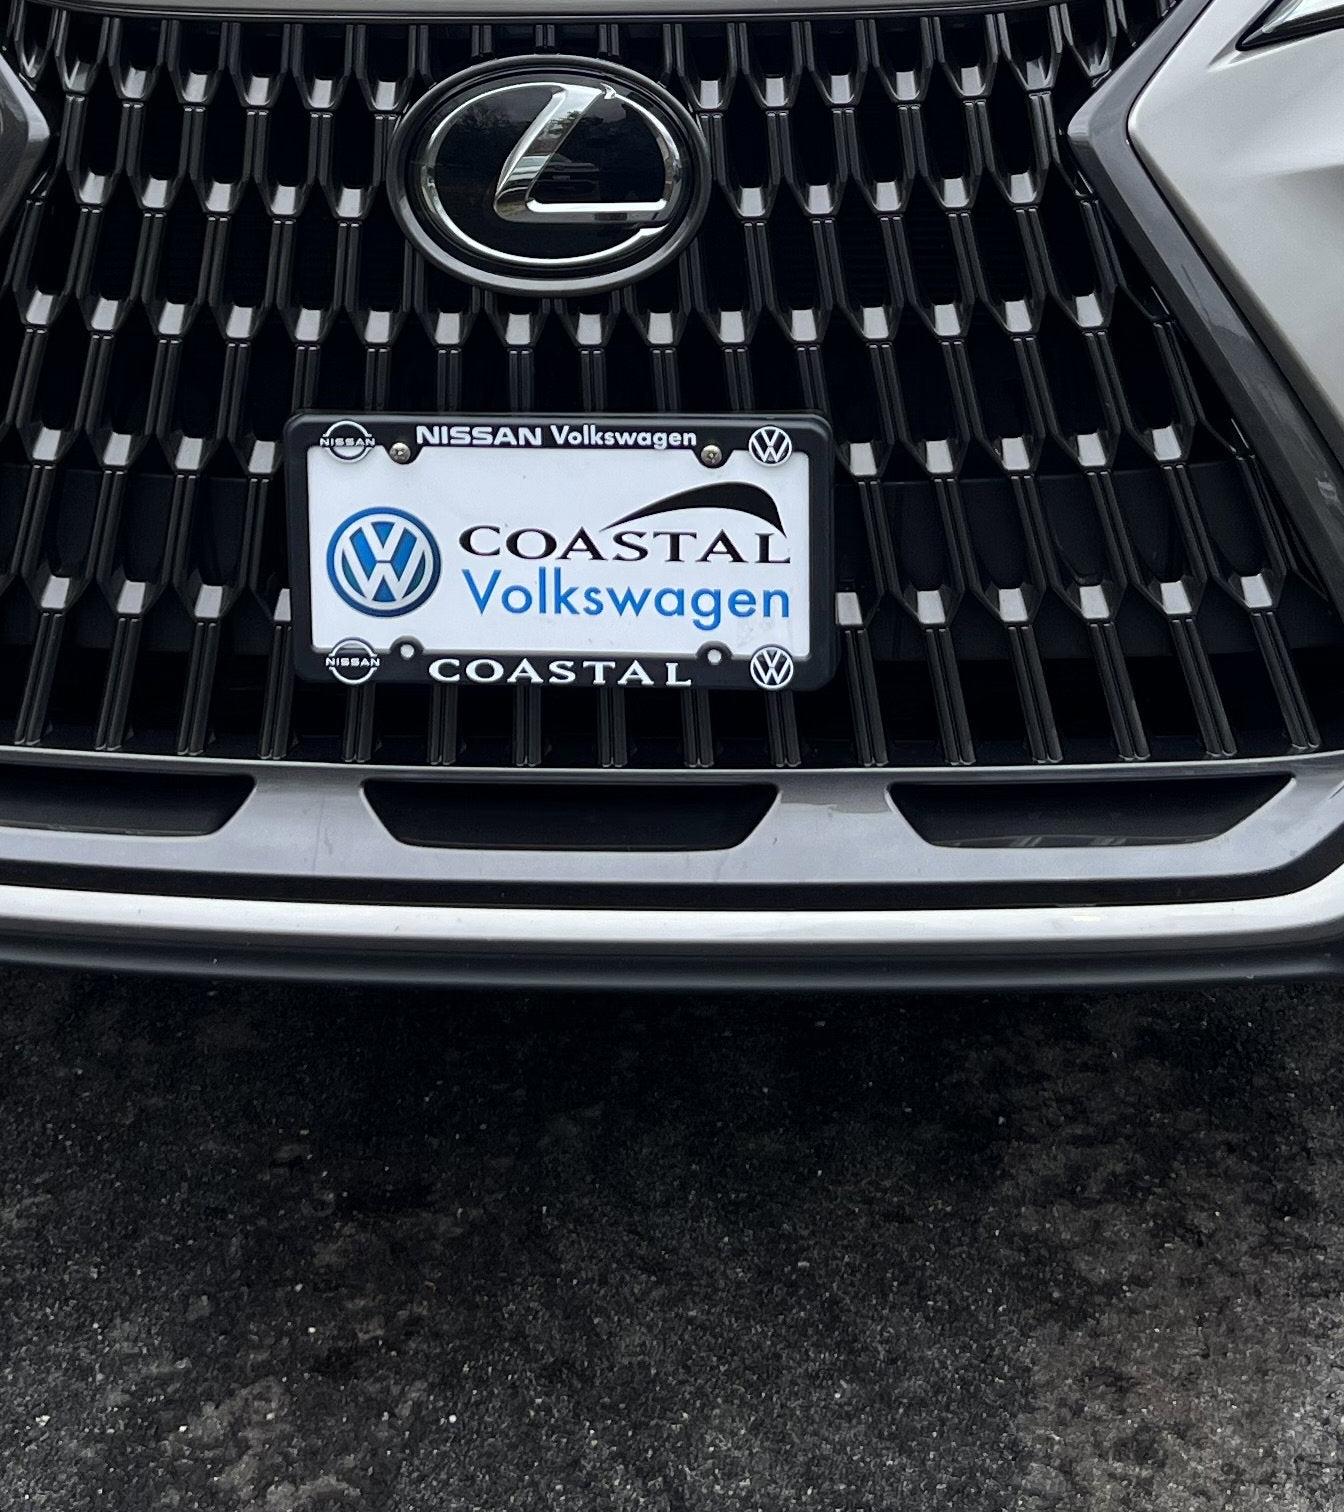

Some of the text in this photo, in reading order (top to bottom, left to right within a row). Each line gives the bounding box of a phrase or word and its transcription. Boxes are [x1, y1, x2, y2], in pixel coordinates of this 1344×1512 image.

[319, 437, 376, 446] NISSAN
[416, 424, 697, 449] NISSAN Volkswagen
[459, 525, 791, 564] COASTAL
[462, 567, 790, 631] Volkswagen
[325, 657, 380, 667] NISSAN
[428, 657, 692, 687] COASTAL
